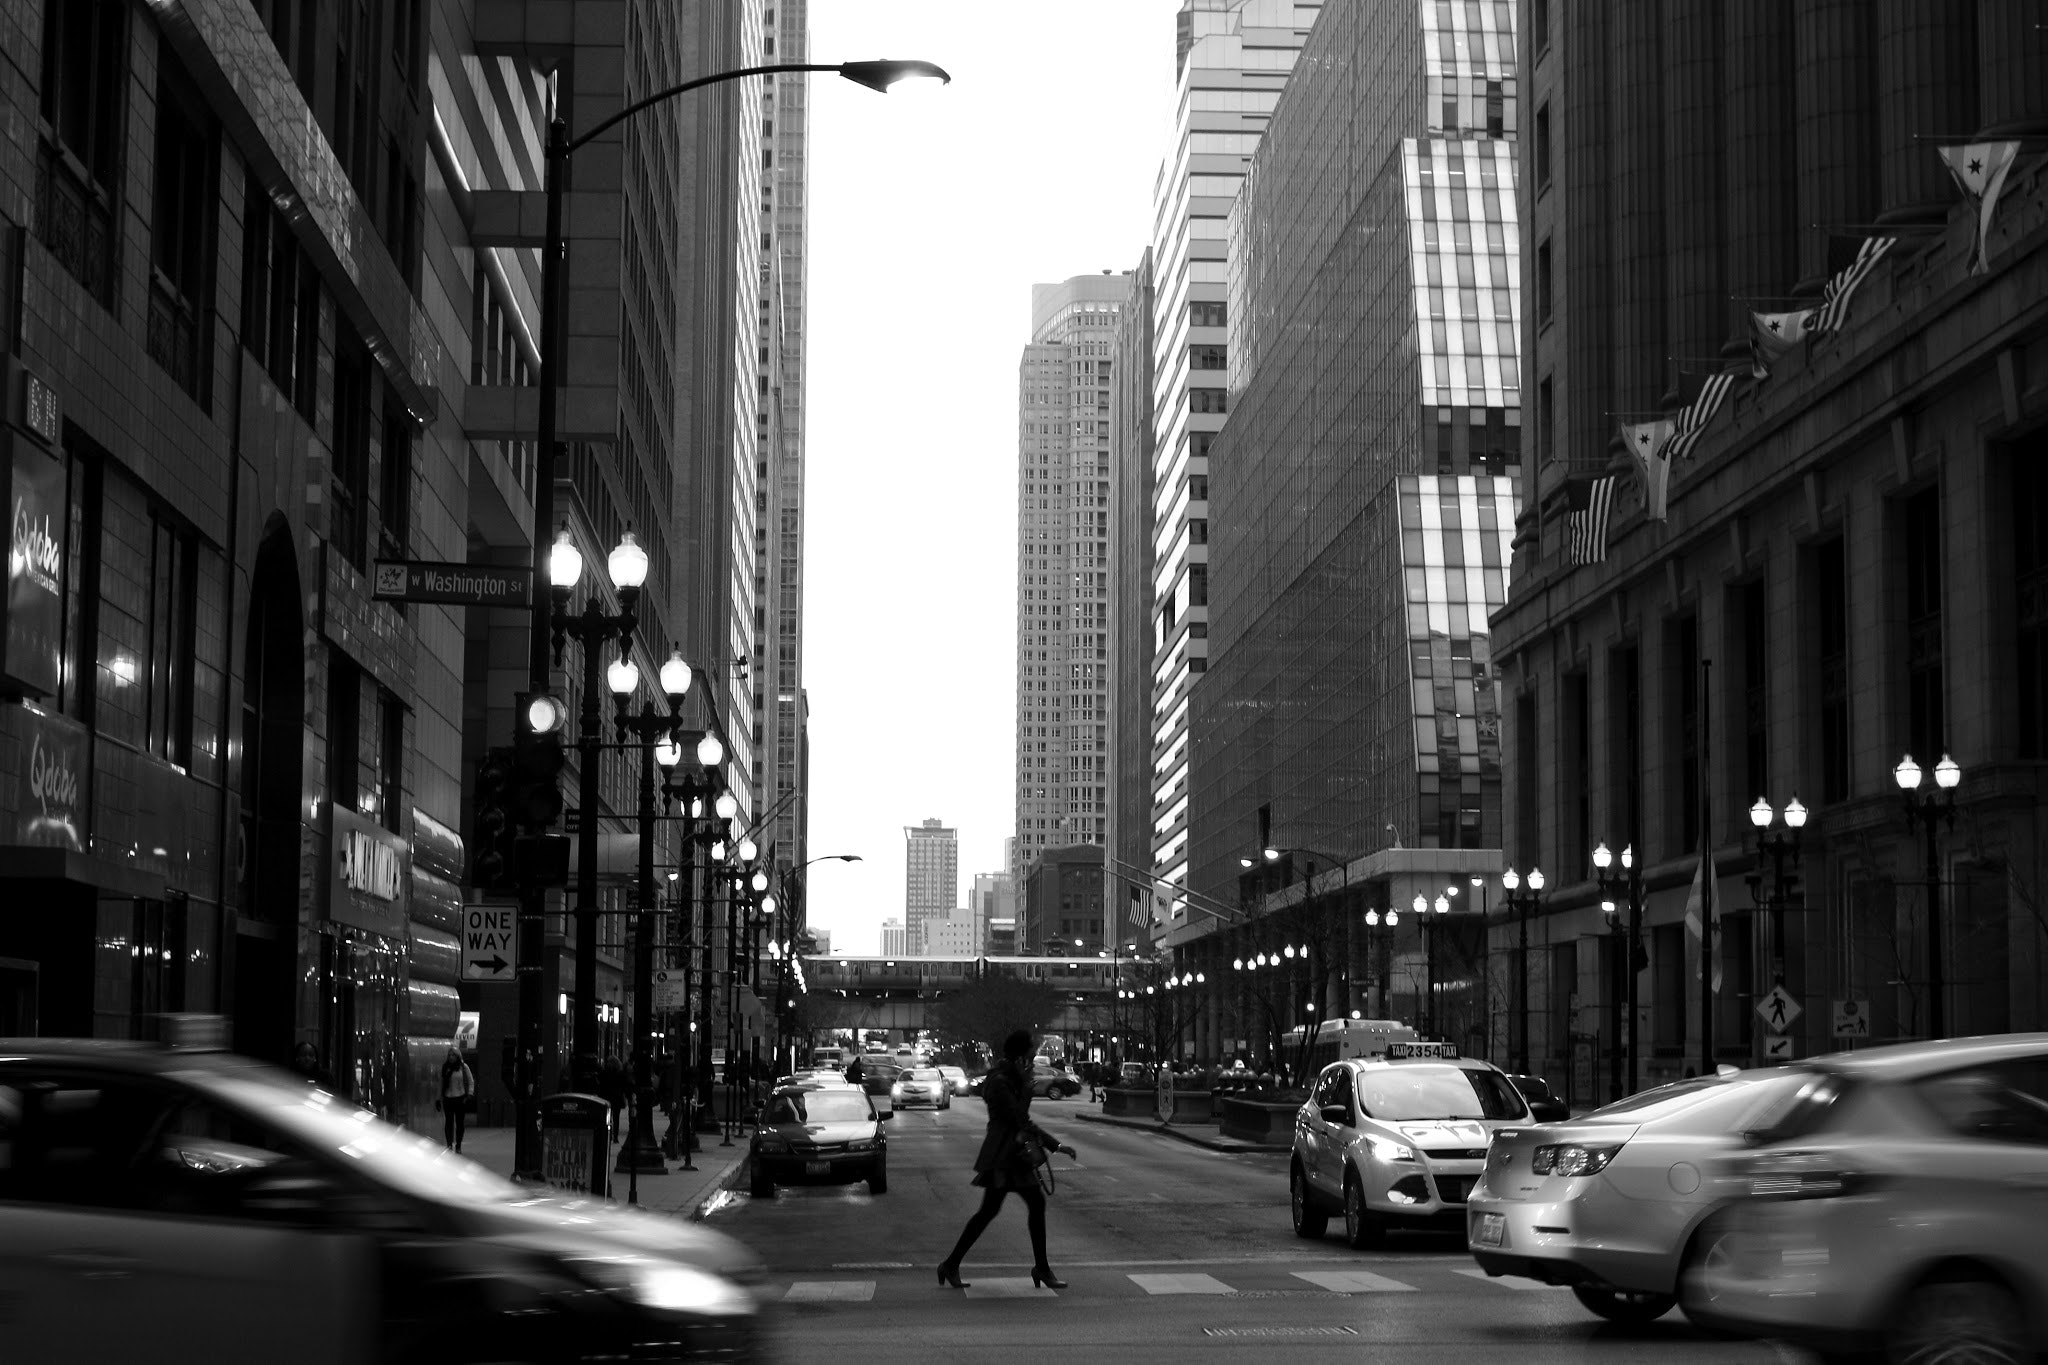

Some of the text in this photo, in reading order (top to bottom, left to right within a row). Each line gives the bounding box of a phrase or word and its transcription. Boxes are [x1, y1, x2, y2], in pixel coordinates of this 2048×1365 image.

[13, 495, 60, 581] Qdoba
[411, 569, 522, 601] W Washington St
[31, 733, 77, 816] Qdoba
[469, 912, 512, 929] ONE
[468, 932, 512, 951] WAY
[1391, 1045, 1457, 1058] TAXI 2354 TAXI
